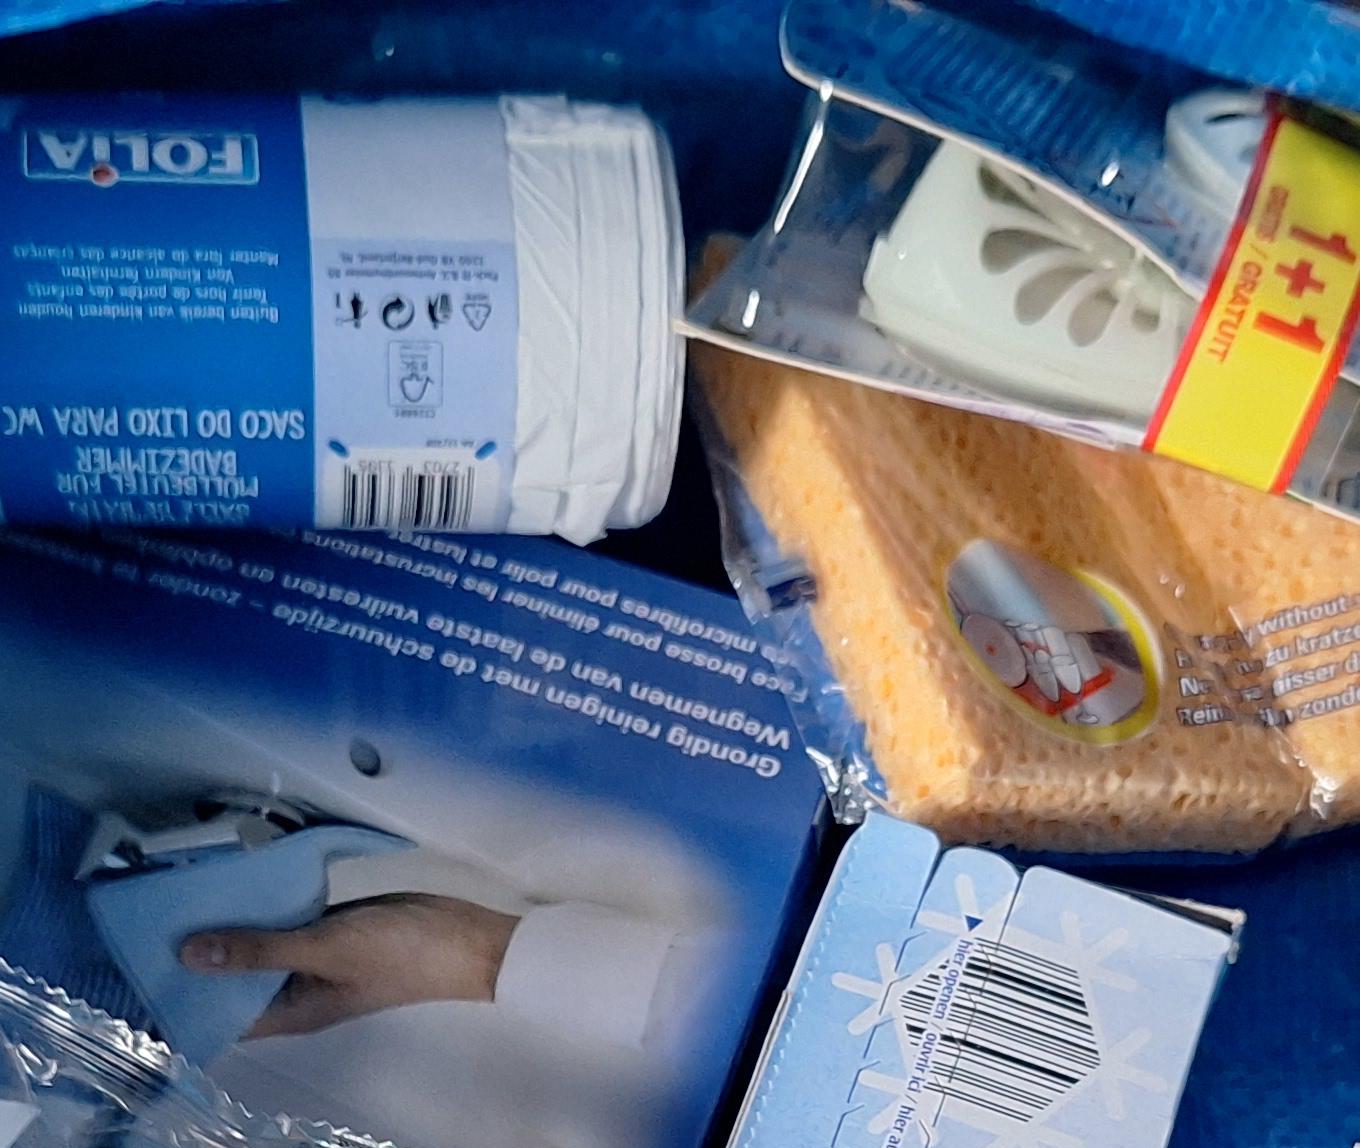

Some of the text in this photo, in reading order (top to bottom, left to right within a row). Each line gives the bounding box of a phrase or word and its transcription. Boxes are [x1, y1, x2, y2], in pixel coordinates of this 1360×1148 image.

[1253, 224, 1357, 354] 1+1
[1206, 262, 1263, 364] GRATUIT
[0, 405, 304, 439] SACO DO LIXO PARA WC
[76, 446, 236, 473] BADEZIMMER
[559, 576, 618, 610] pour
[271, 597, 435, 662] schuurzijde
[601, 618, 662, 652] pour
[614, 596, 757, 655] microfibres
[1255, 598, 1349, 636] without
[424, 613, 525, 661] laatste
[437, 646, 478, 676] de
[480, 661, 540, 694] met
[527, 646, 566, 674] de
[569, 660, 625, 692] van
[661, 640, 748, 684] brosse
[543, 679, 665, 738] reinigen
[627, 678, 794, 748] Wegnemen
[664, 722, 783, 778] Grondig
[953, 938, 972, 965] hier
[931, 967, 960, 1020] openen
[913, 1031, 939, 1073] ouvrir
[908, 1075, 925, 1093] ici
[891, 1104, 914, 1134] hier
